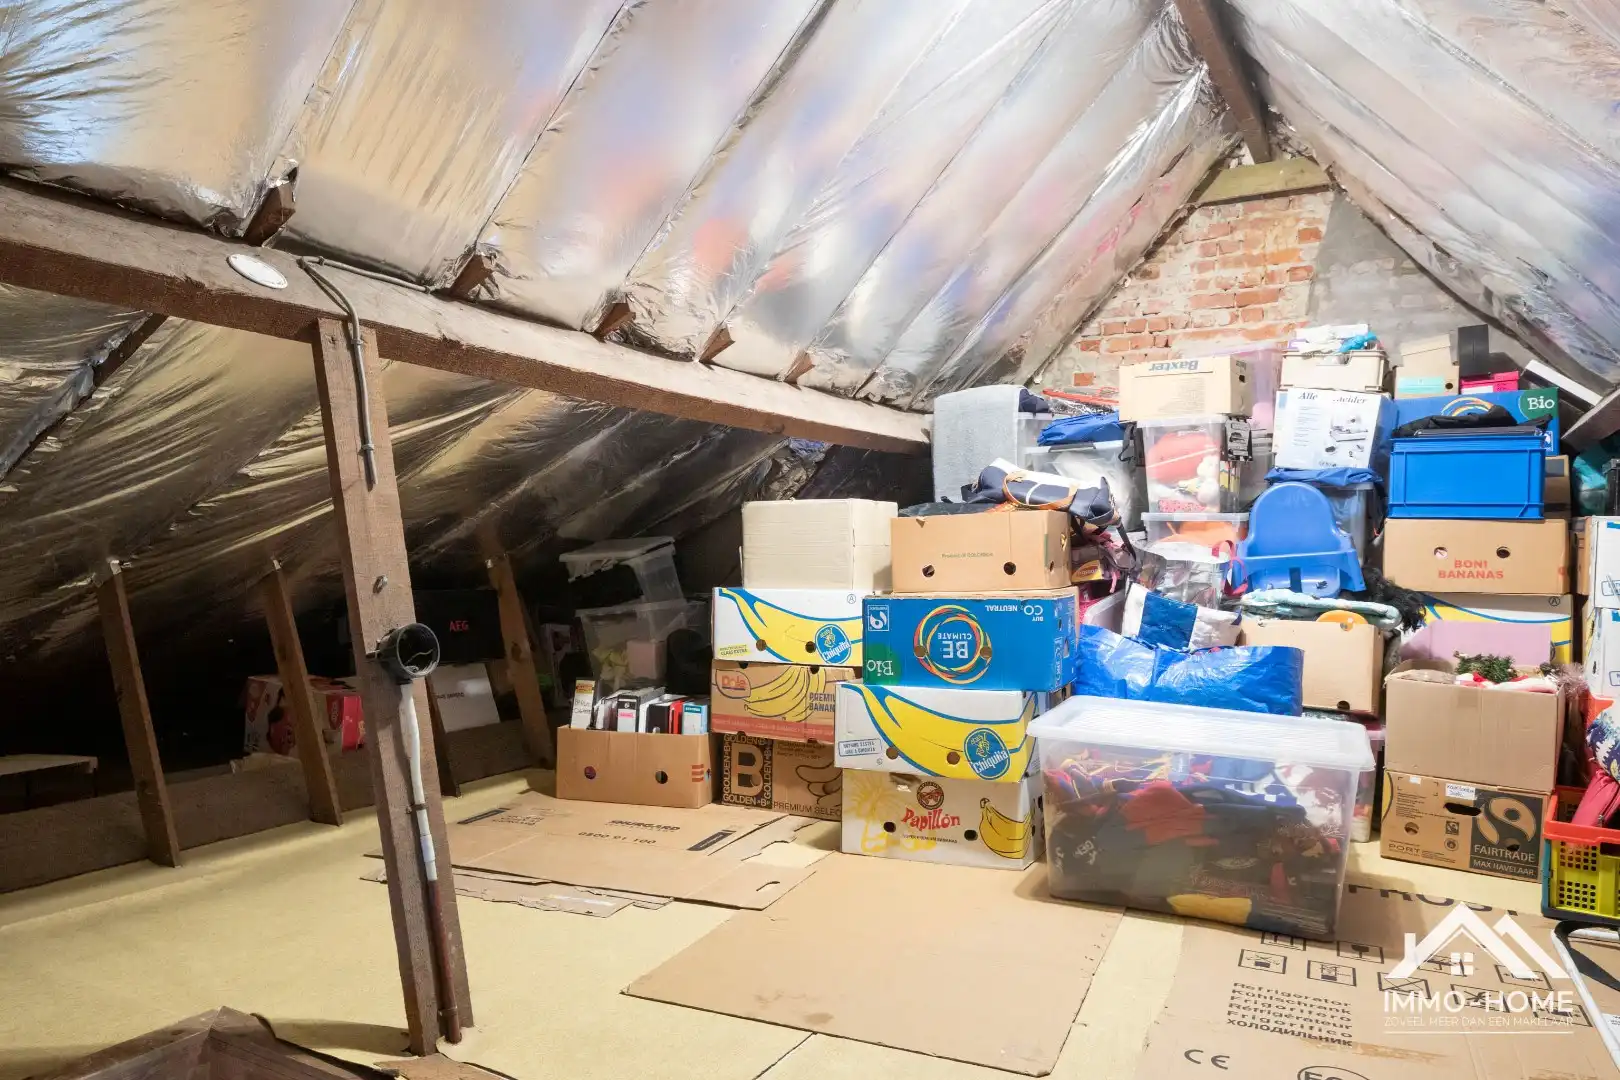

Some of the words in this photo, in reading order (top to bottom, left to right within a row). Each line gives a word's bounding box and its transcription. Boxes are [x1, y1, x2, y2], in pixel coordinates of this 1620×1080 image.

[1148, 360, 1199, 372] Baxter
[1527, 395, 1556, 410] Bio
[1454, 559, 1488, 568] BONI
[1437, 570, 1505, 580] BANANAS
[985, 604, 1018, 612] NEUTRAL
[449, 620, 470, 632] AEG
[937, 632, 973, 640] CLIMATE
[821, 640, 852, 662] Chiquita
[942, 641, 969, 659] BE
[866, 659, 894, 677] Bio
[721, 675, 747, 689] Dole
[731, 743, 763, 796] B
[972, 750, 1010, 774] Chiquita
[722, 757, 731, 793] GOLDEN
[763, 760, 772, 799] GOLDEN
[722, 793, 757, 806] GOLDEN
[773, 800, 812, 813] PREMIUM
[1473, 843, 1536, 863] FAIRTRADE
[1472, 859, 1492, 870] MAX
[1493, 862, 1535, 877] HAVELAAR
[1231, 989, 1352, 1015] Kühlschrank
[1233, 982, 1352, 1007] Refrigerator
[1228, 1002, 1353, 1030] Réfrigérateur
[1230, 995, 1352, 1022] Frigorifero
